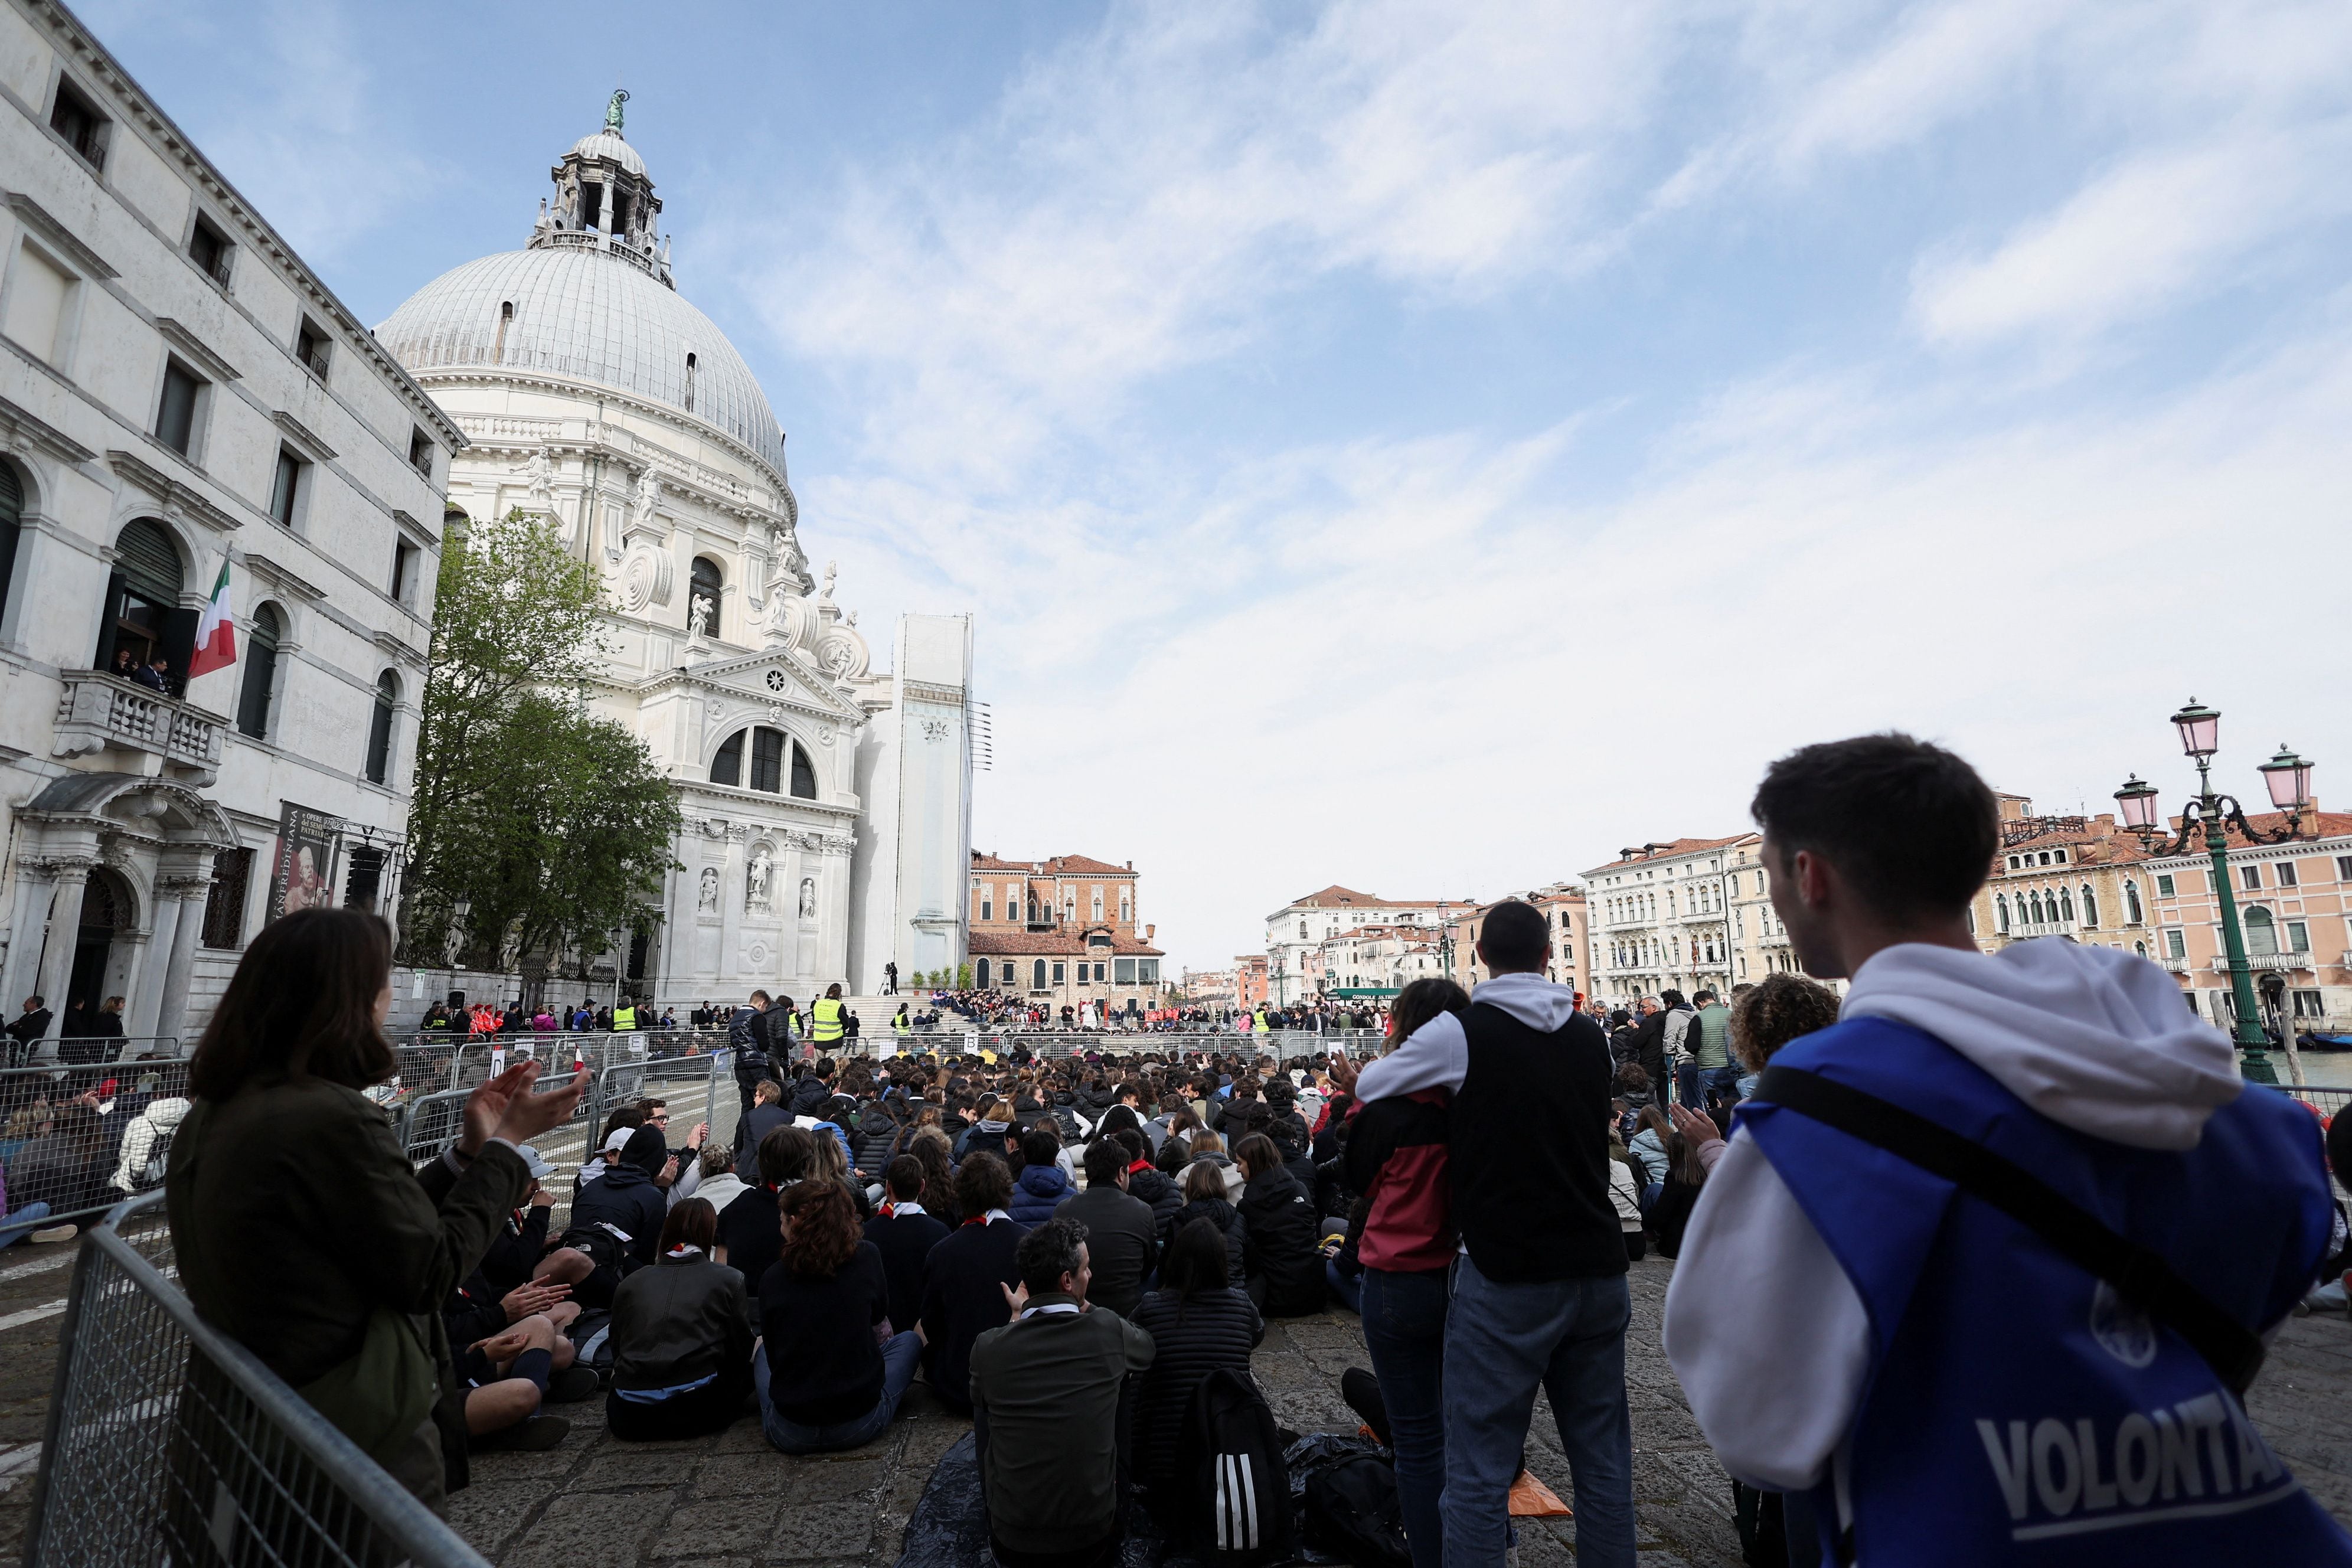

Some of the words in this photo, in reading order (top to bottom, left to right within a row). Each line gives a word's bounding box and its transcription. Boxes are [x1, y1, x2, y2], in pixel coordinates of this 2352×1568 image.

[306, 813, 322, 823] OPERE
[968, 1037, 975, 1047] B
[492, 1059, 501, 1079] D
[1975, 1387, 2284, 1520] VOLONTA
